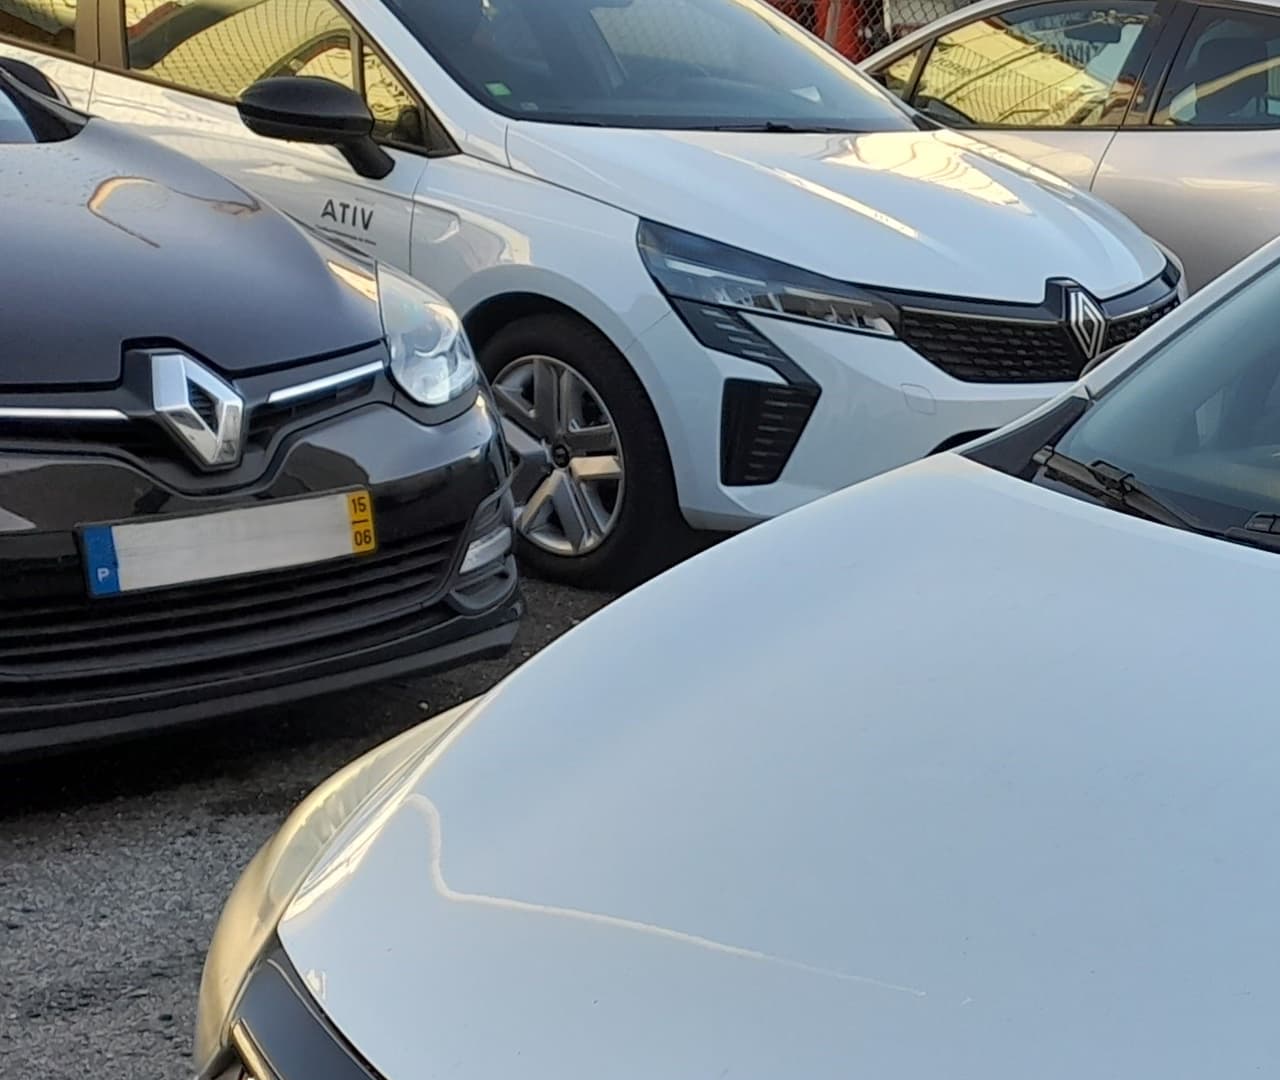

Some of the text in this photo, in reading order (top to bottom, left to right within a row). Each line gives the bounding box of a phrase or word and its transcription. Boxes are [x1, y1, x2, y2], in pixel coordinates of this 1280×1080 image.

[321, 198, 374, 231] ATIV
[351, 497, 368, 514] 15
[354, 529, 372, 547] 06
[97, 567, 110, 582] P
